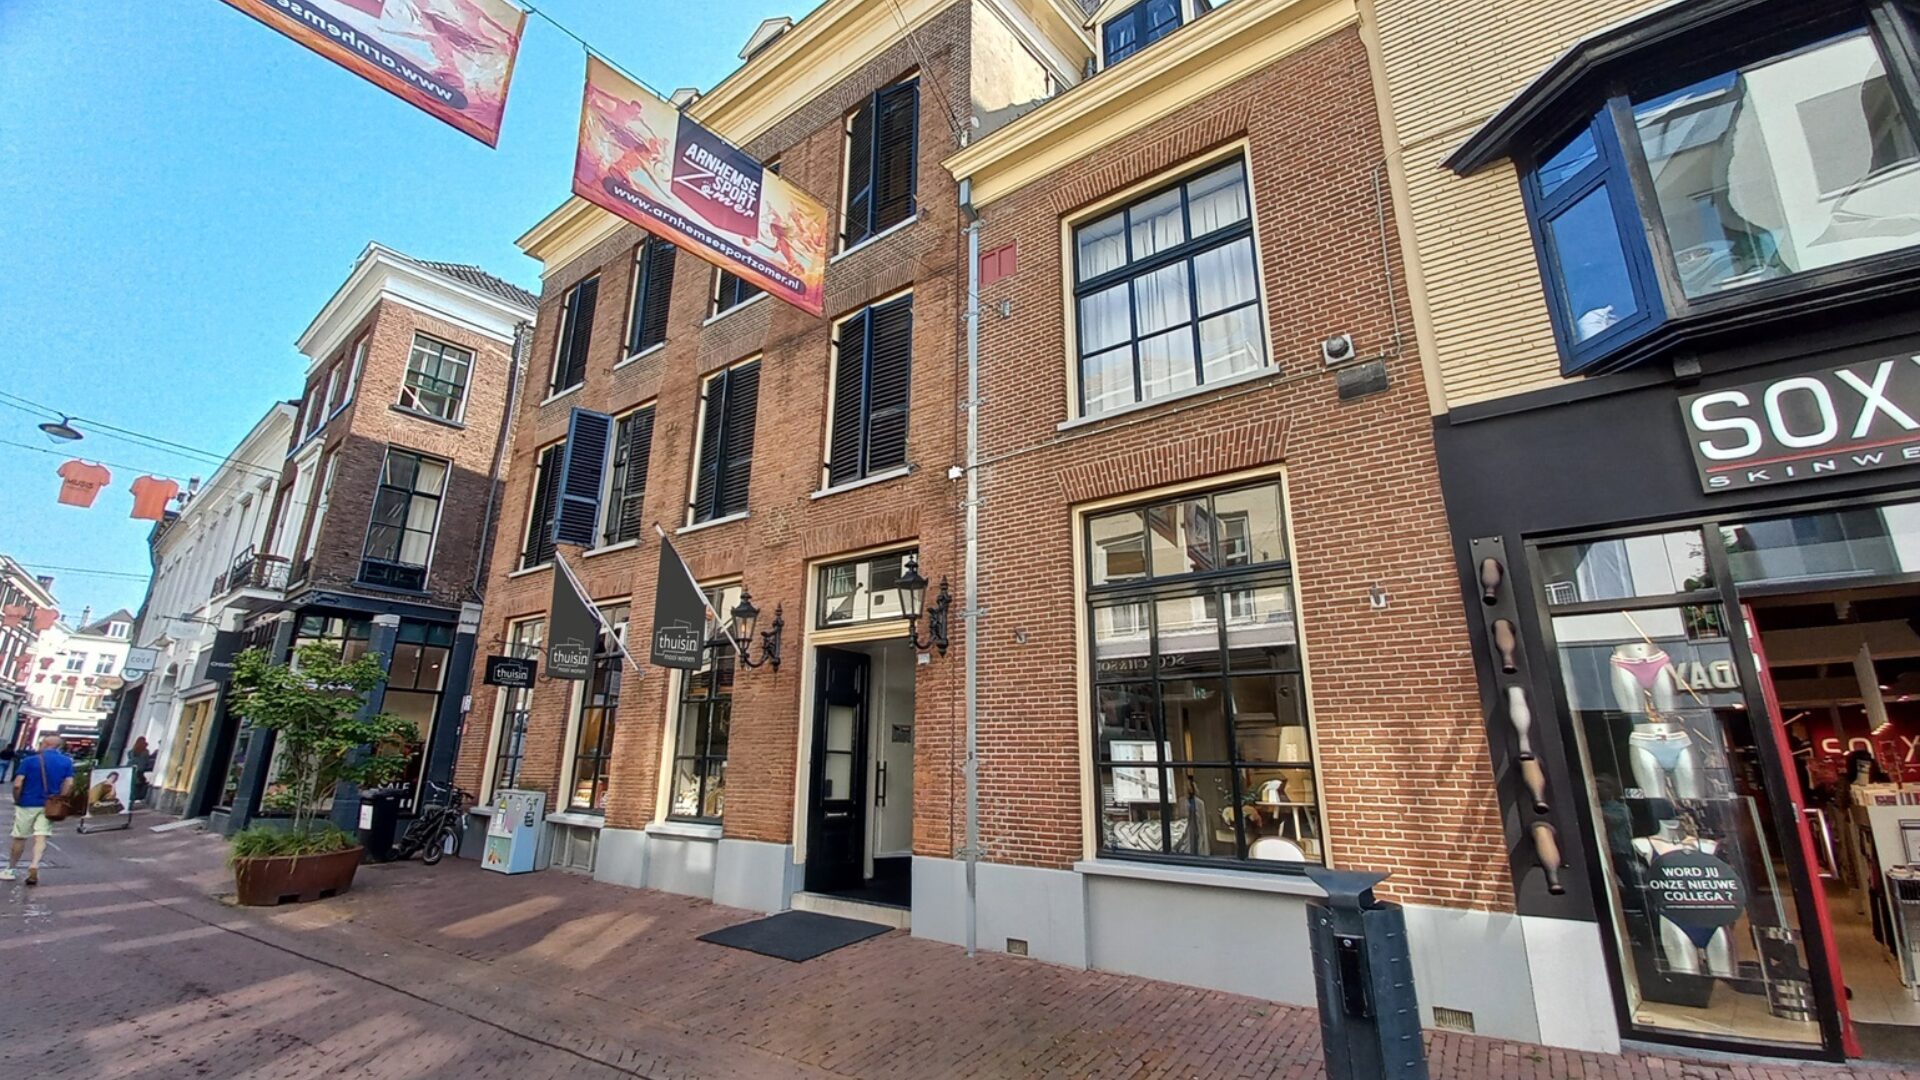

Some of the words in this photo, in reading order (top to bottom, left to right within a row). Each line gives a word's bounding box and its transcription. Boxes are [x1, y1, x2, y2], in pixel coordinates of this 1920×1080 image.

[685, 142, 760, 197] ARNHEMSE
[711, 177, 757, 211] SPORT
[612, 185, 800, 291] www.arnhemsesportzomer.nl
[1690, 355, 1920, 460] SOX
[659, 634, 698, 651] thuisin
[552, 650, 588, 665] thuisin
[496, 668, 528, 680] thuisin
[1661, 867, 1703, 877] WORD
[1649, 880, 1686, 890] ONZE
[1687, 880, 1739, 890] NIEUWE
[1664, 891, 1724, 901] COLLEGA
